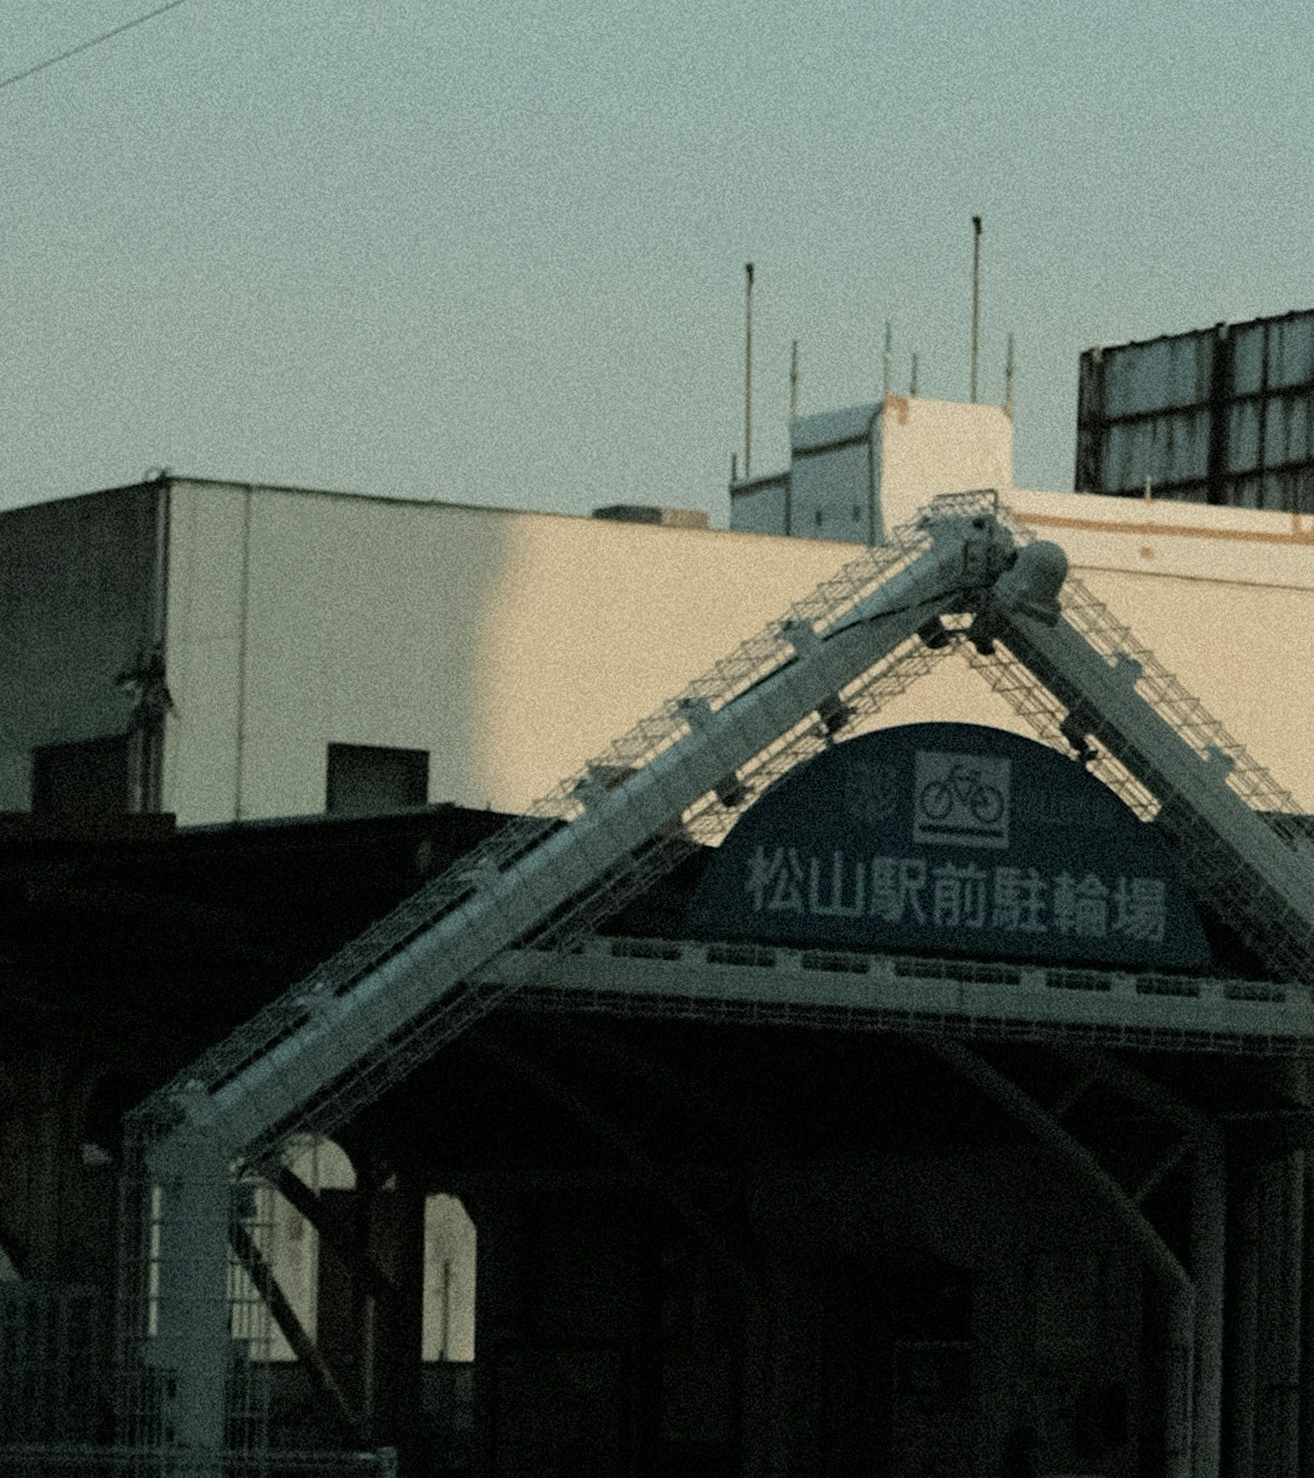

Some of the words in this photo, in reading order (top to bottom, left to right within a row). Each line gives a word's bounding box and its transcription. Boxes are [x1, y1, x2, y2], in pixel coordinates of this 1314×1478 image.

[744, 844, 1167, 942] 松山駅前駐輪場
